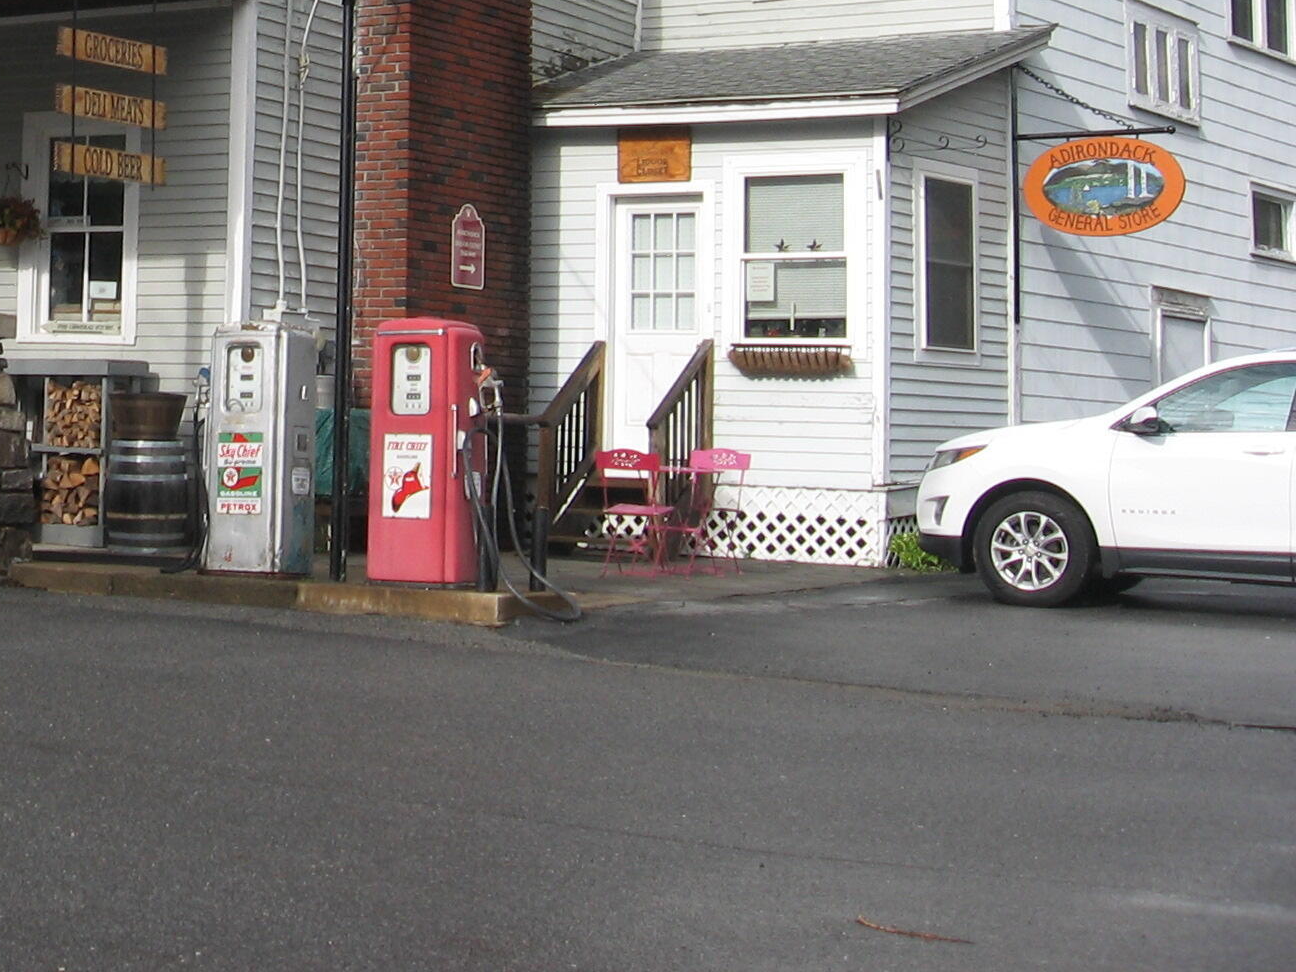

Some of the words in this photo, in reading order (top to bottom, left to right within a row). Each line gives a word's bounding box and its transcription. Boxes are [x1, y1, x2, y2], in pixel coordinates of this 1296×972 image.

[84, 33, 144, 69] GROCERIES
[84, 90, 107, 118] DELI
[110, 95, 144, 125] MEATS
[84, 148, 114, 176] COLD
[117, 152, 143, 181] BEER
[1049, 141, 1156, 169] ADIRONDACK
[1048, 208, 1113, 232] GENERAL
[1118, 204, 1161, 229] STORE
[219, 444, 236, 459] Sky
[237, 444, 262, 458] Chief
[220, 503, 257, 511] PETROX
